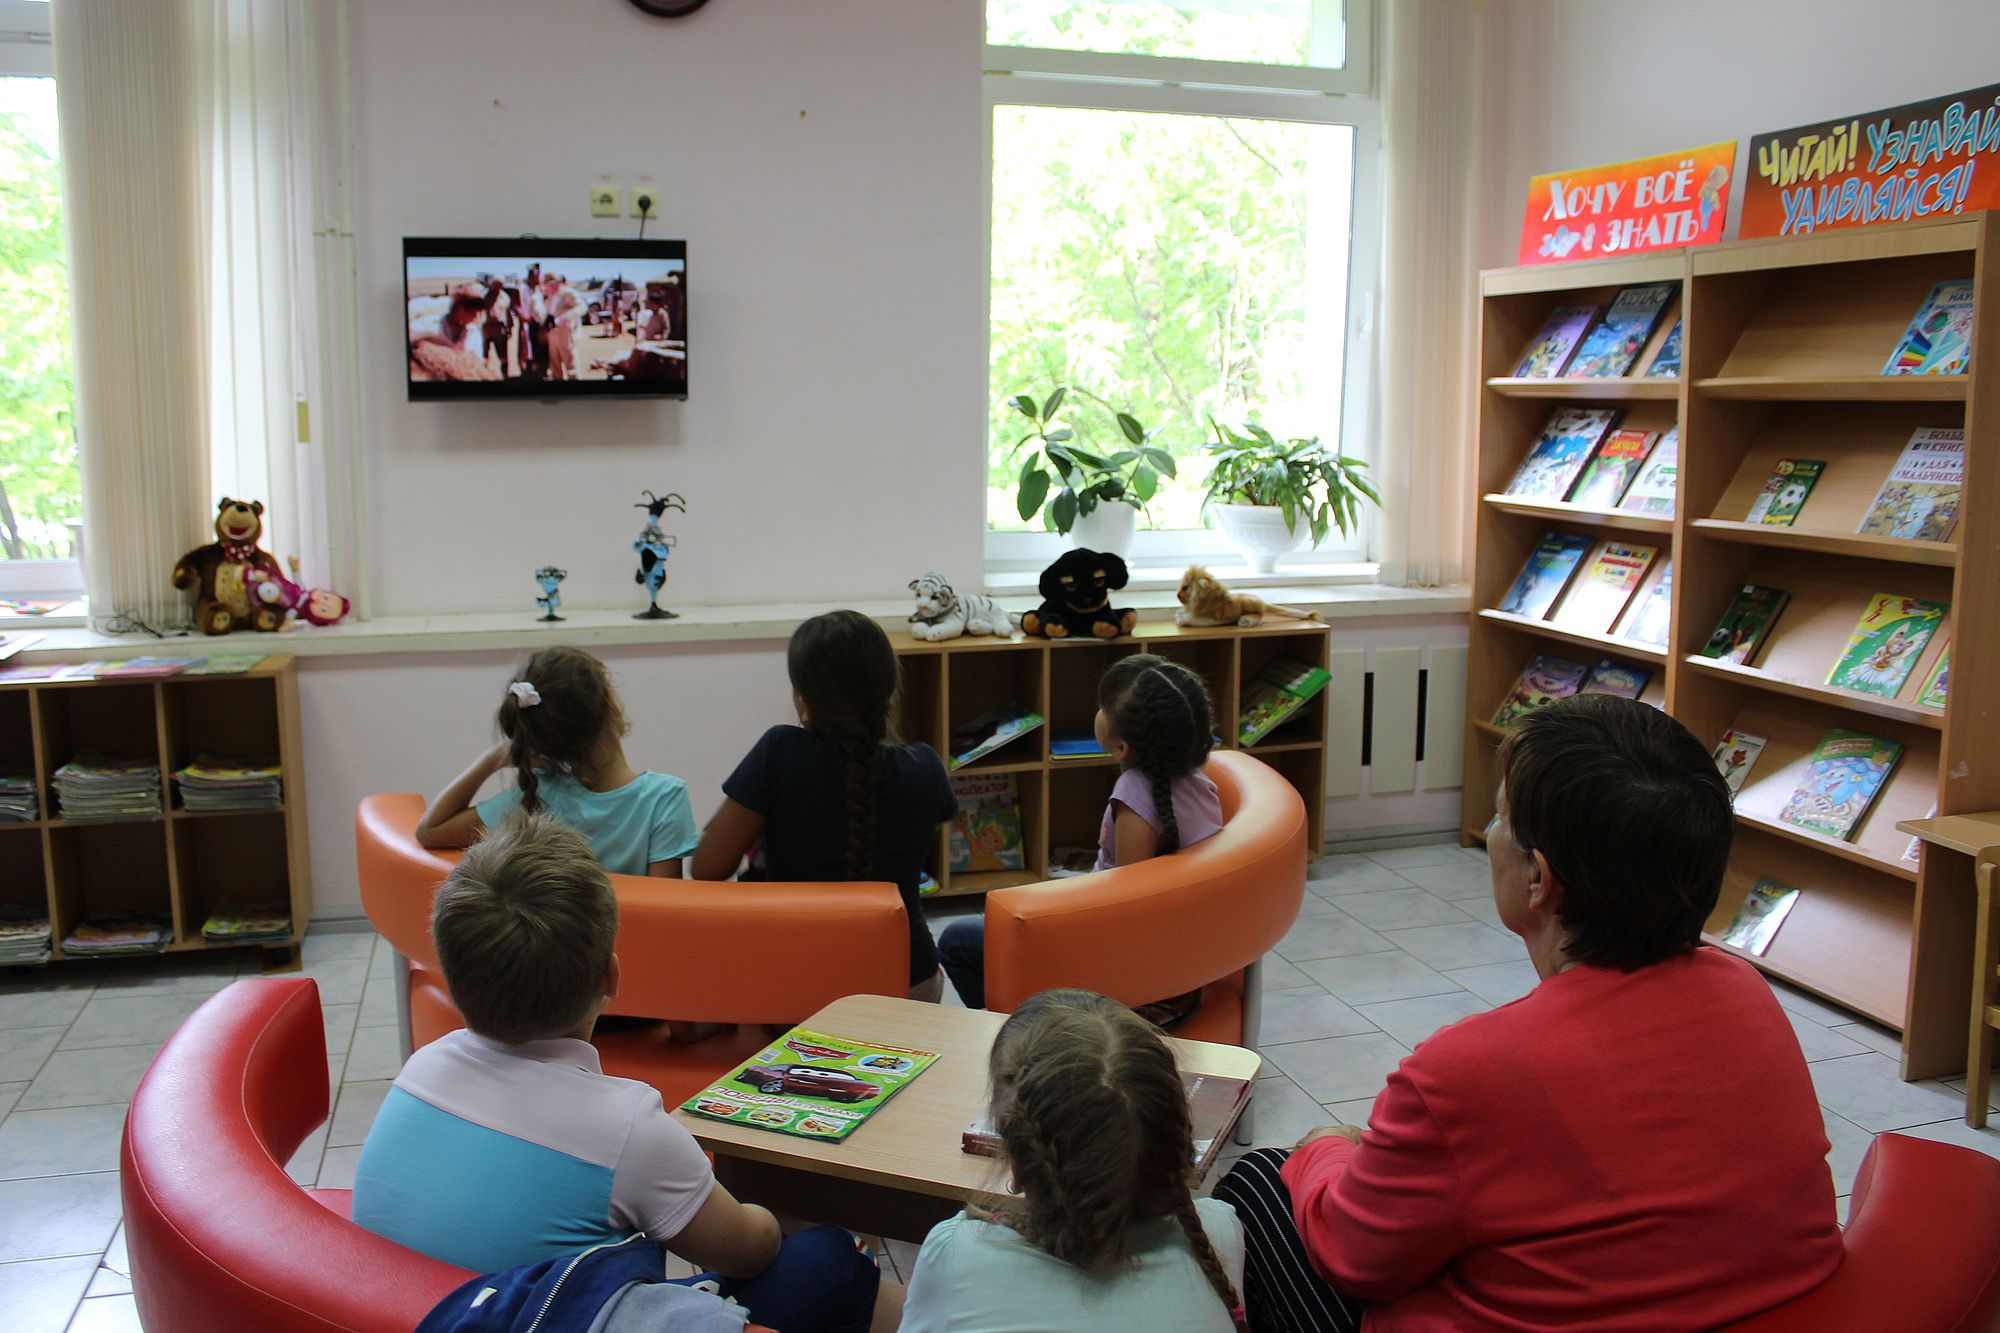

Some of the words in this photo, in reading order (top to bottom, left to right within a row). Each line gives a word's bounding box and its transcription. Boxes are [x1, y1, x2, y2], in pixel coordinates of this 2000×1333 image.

[1758, 120, 1860, 187] ЧИТАЙ!
[1866, 95, 2000, 176] УЗНАВАЙ
[1542, 178, 1628, 222] ХОЧУ
[1633, 158, 1696, 209] ВСЁ
[1779, 159, 1976, 236] УДИВЛЯЙСЯ!
[1600, 208, 1699, 253] ЗНАТЬ
